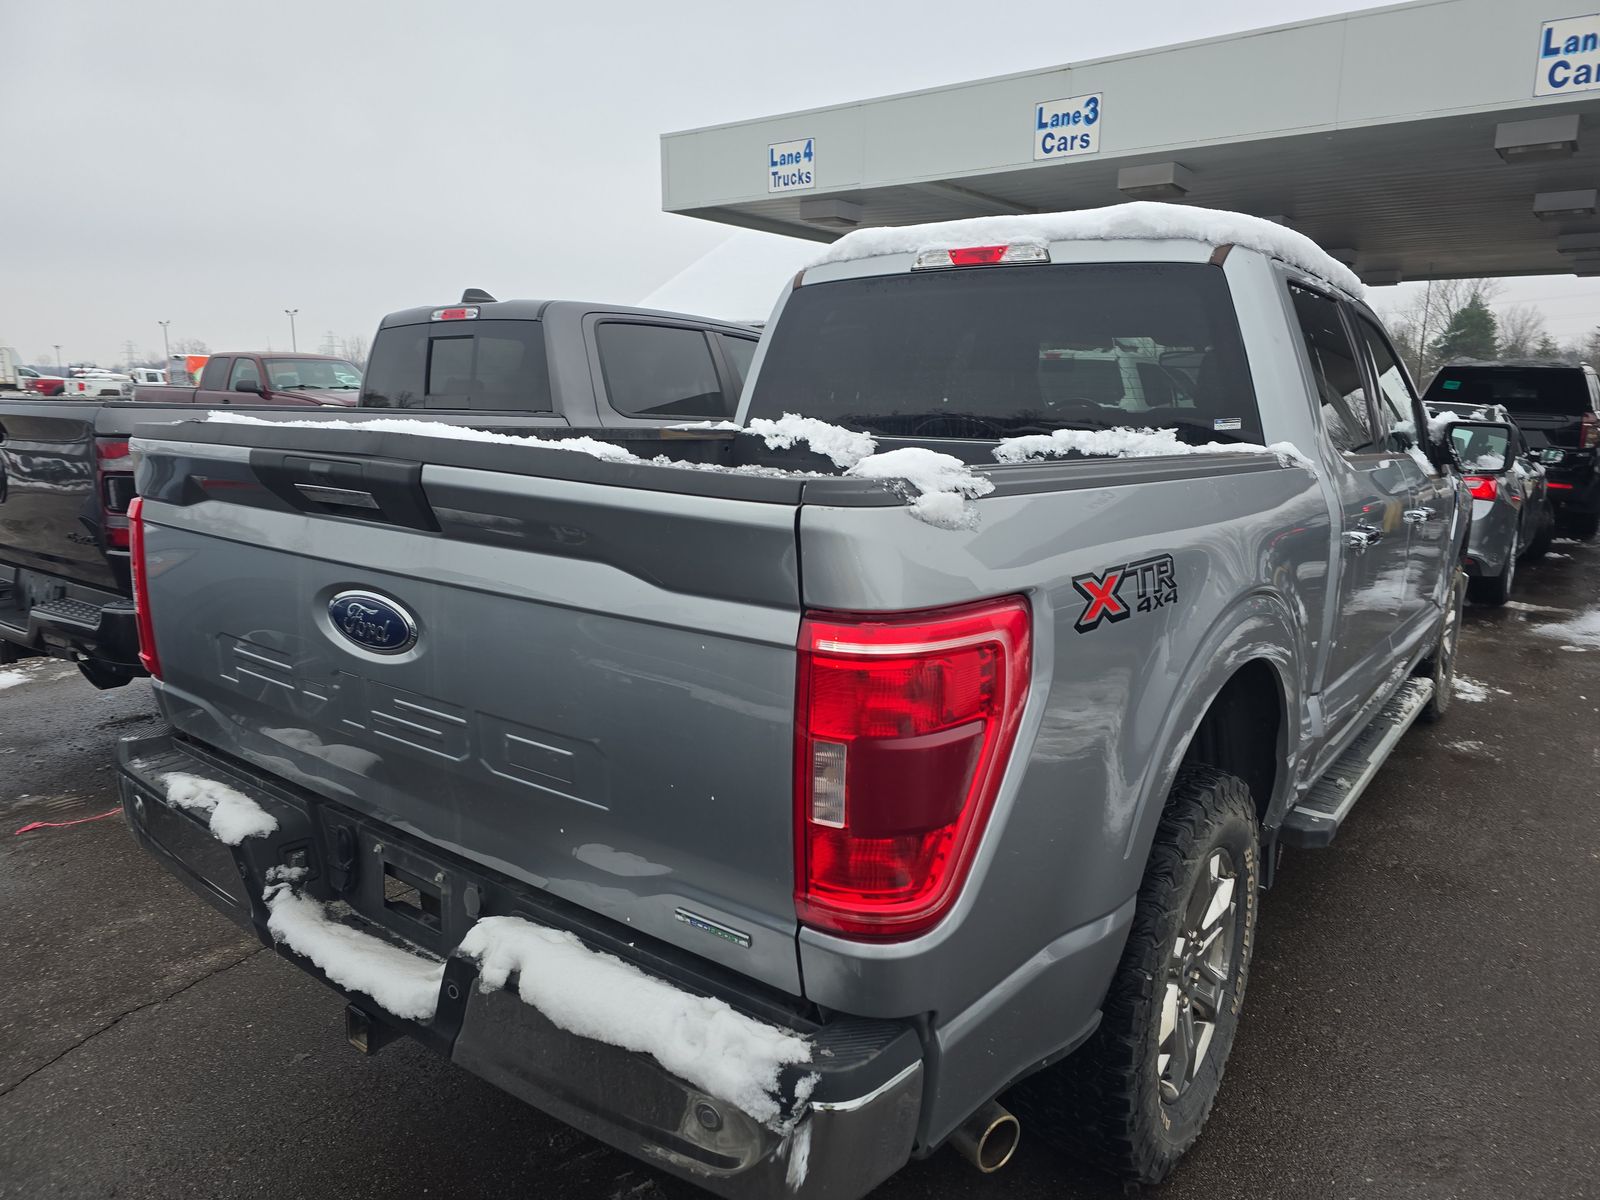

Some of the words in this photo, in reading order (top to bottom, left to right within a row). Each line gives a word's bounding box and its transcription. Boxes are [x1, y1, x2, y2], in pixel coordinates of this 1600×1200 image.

[1542, 26, 1600, 58] Lan
[1037, 106, 1082, 130] Lane
[1083, 96, 1099, 126] 3
[770, 148, 801, 167] Lane
[803, 139, 813, 162] 4
[1041, 132, 1090, 154] Cars
[771, 168, 812, 188] Trucks
[1072, 553, 1177, 634] XTR
[343, 602, 391, 643] Ford
